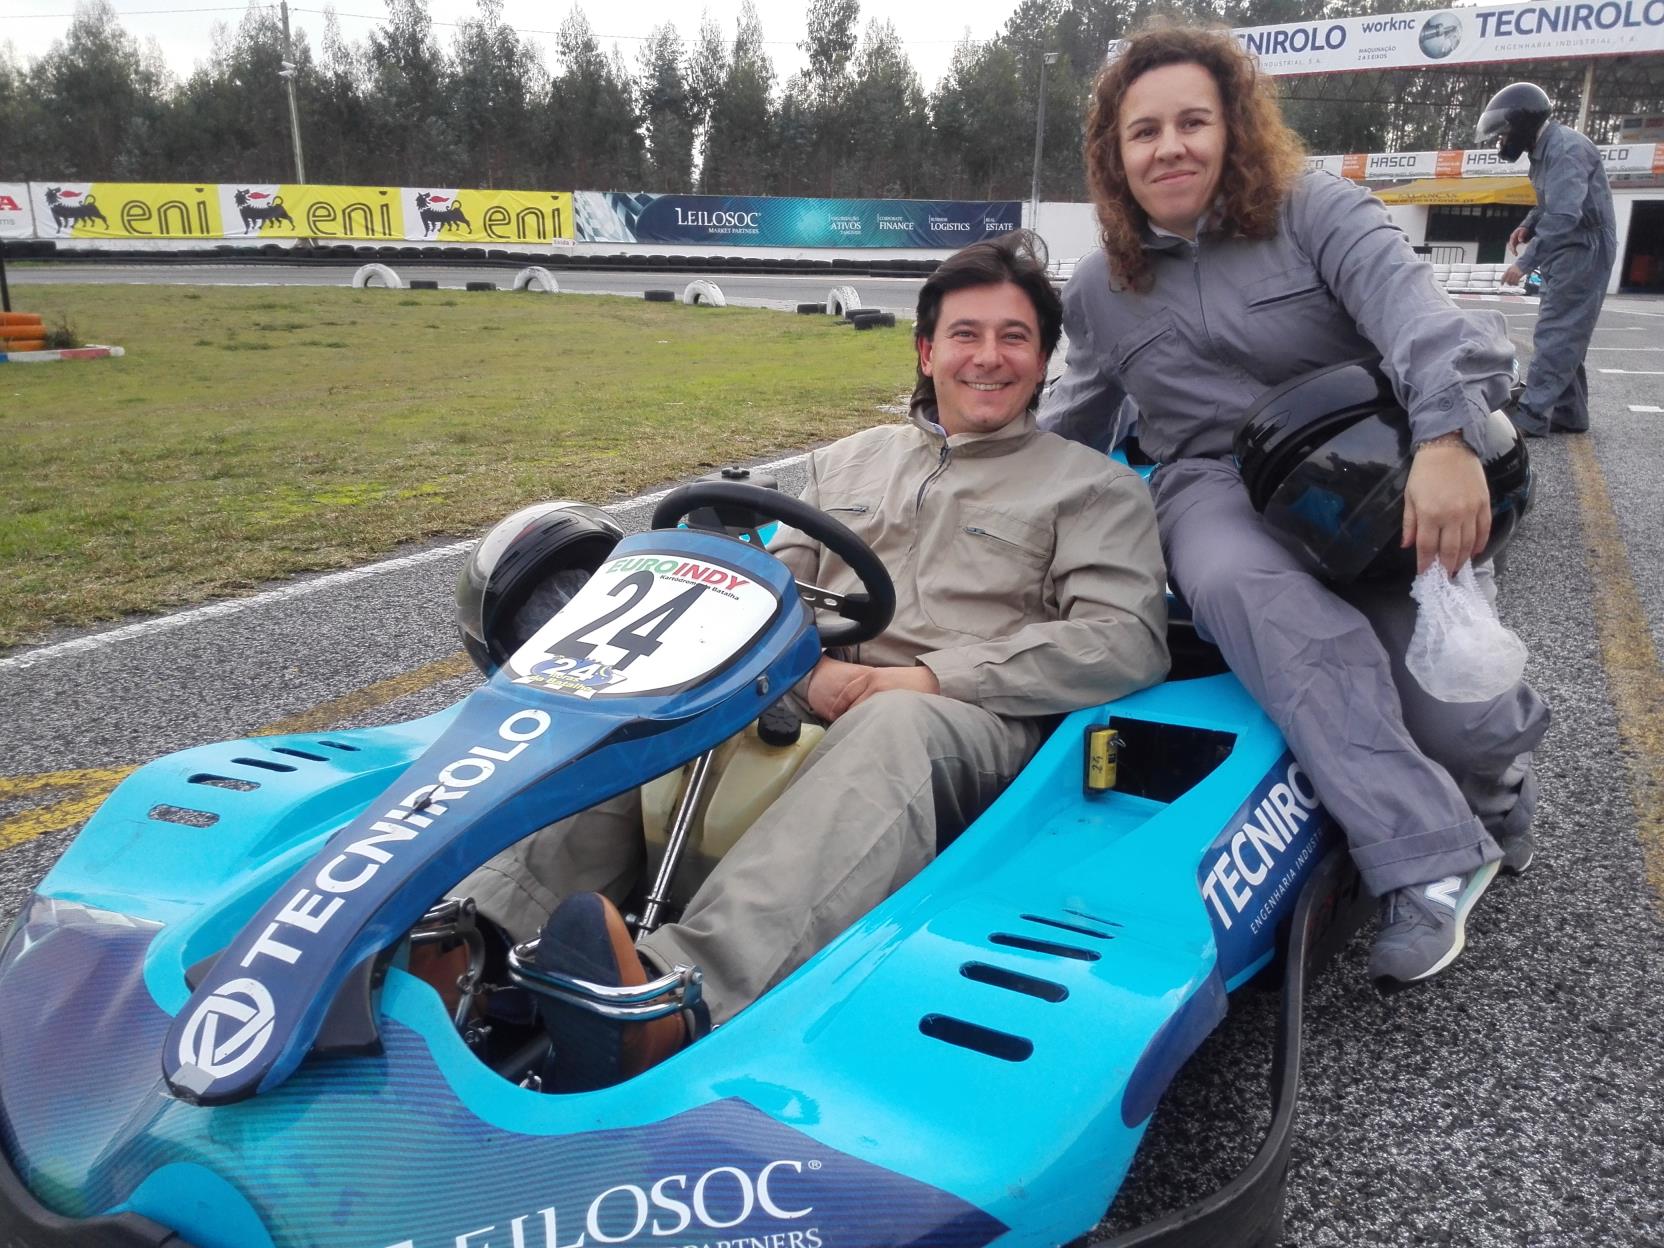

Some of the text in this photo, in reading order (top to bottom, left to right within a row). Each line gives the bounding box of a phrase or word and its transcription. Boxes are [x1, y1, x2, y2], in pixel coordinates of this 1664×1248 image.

[1361, 17, 1416, 33] worknc
[1475, 0, 1664, 38] TECNIROLO
[1494, 42, 1551, 52] ENGENHARIA
[1370, 156, 1416, 168] HASCO
[120, 187, 206, 237] eni
[307, 190, 392, 237] eni
[483, 195, 562, 240] eni
[830, 221, 862, 231] ATIVOS
[879, 222, 915, 231] FINANCE
[930, 222, 971, 231] LOGISTICS
[985, 222, 1014, 231] ESTATE
[605, 558, 750, 591] EUROINDY
[660, 574, 699, 587] Kartodrom
[711, 586, 740, 601] Batalha
[543, 570, 708, 671] 24
[541, 658, 602, 681] 24
[239, 709, 552, 968] TECNIROLO
[1250, 868, 1297, 934] ENGENHARIA
